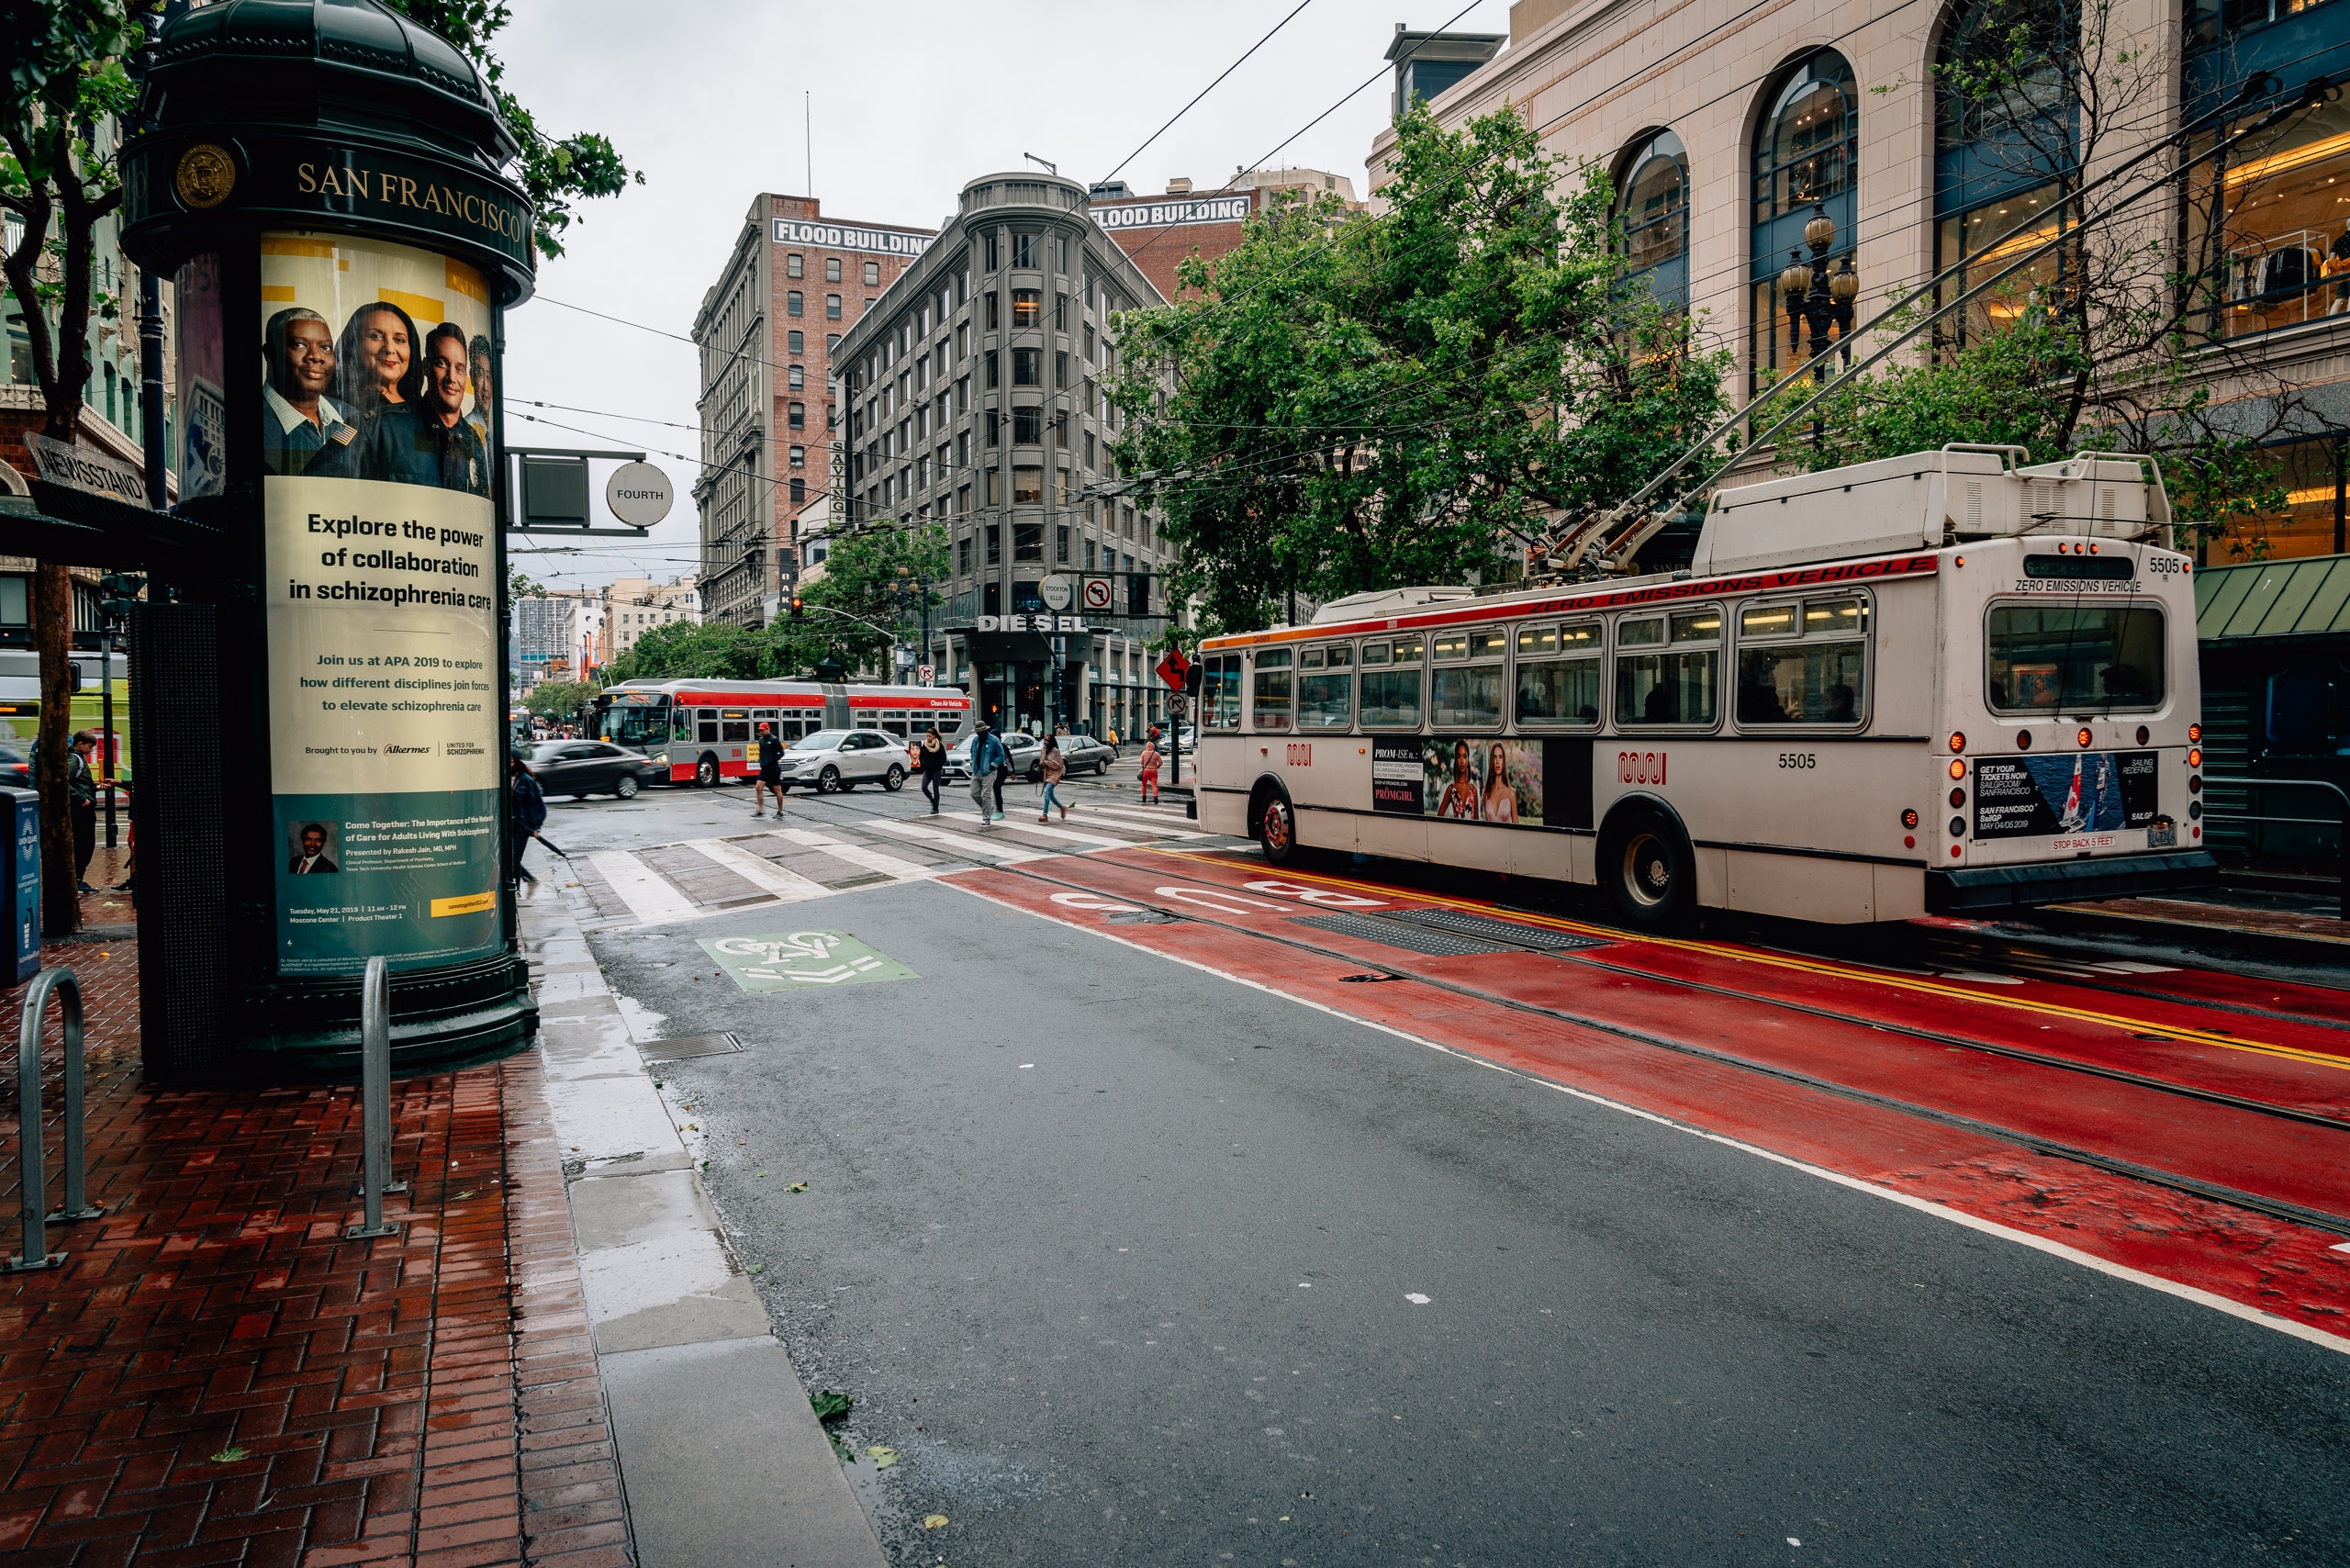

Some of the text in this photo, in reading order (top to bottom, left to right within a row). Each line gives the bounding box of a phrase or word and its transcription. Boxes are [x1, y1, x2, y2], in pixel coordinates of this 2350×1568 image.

[298, 162, 521, 243] SAN FRANCISCO
[1152, 200, 1245, 223] BUILDING
[778, 222, 841, 245] FLOOD
[37, 447, 143, 499] NEWSSTAND
[832, 442, 844, 512] SAVING
[617, 490, 663, 500] FOURTH
[308, 513, 483, 548] Explore the power
[321, 548, 479, 578] of collaboration
[2150, 557, 2179, 574] 5505
[781, 573, 790, 612] OAK
[1529, 556, 1933, 614] ZERO EMISSIONS VEHICLE
[2015, 580, 2142, 593] ZERO EMISSIONS VEHICLE
[289, 579, 491, 610] in schizophrenia care
[978, 614, 1088, 633] DIESEL
[317, 655, 482, 671] Join us at APA 2019 to explore
[300, 677, 490, 692] how different disciplines join forces
[322, 700, 481, 712] to elevate schizophrenia care
[305, 746, 338, 756] Brought
[351, 748, 366, 757] you
[367, 747, 377, 756] by
[1375, 748, 1409, 759] PROM-ISE
[1778, 753, 1817, 769] 5505
[2122, 766, 2153, 775] REDEFINED
[1980, 787, 2030, 796] SANFRANCISCO
[1995, 805, 2034, 814] FRANCISCO
[371, 820, 410, 830] Together:
[426, 818, 464, 828] Importance
[378, 832, 390, 841] for
[419, 830, 440, 840] Living
[2053, 836, 2114, 850] STOP BACK 5 FEET
